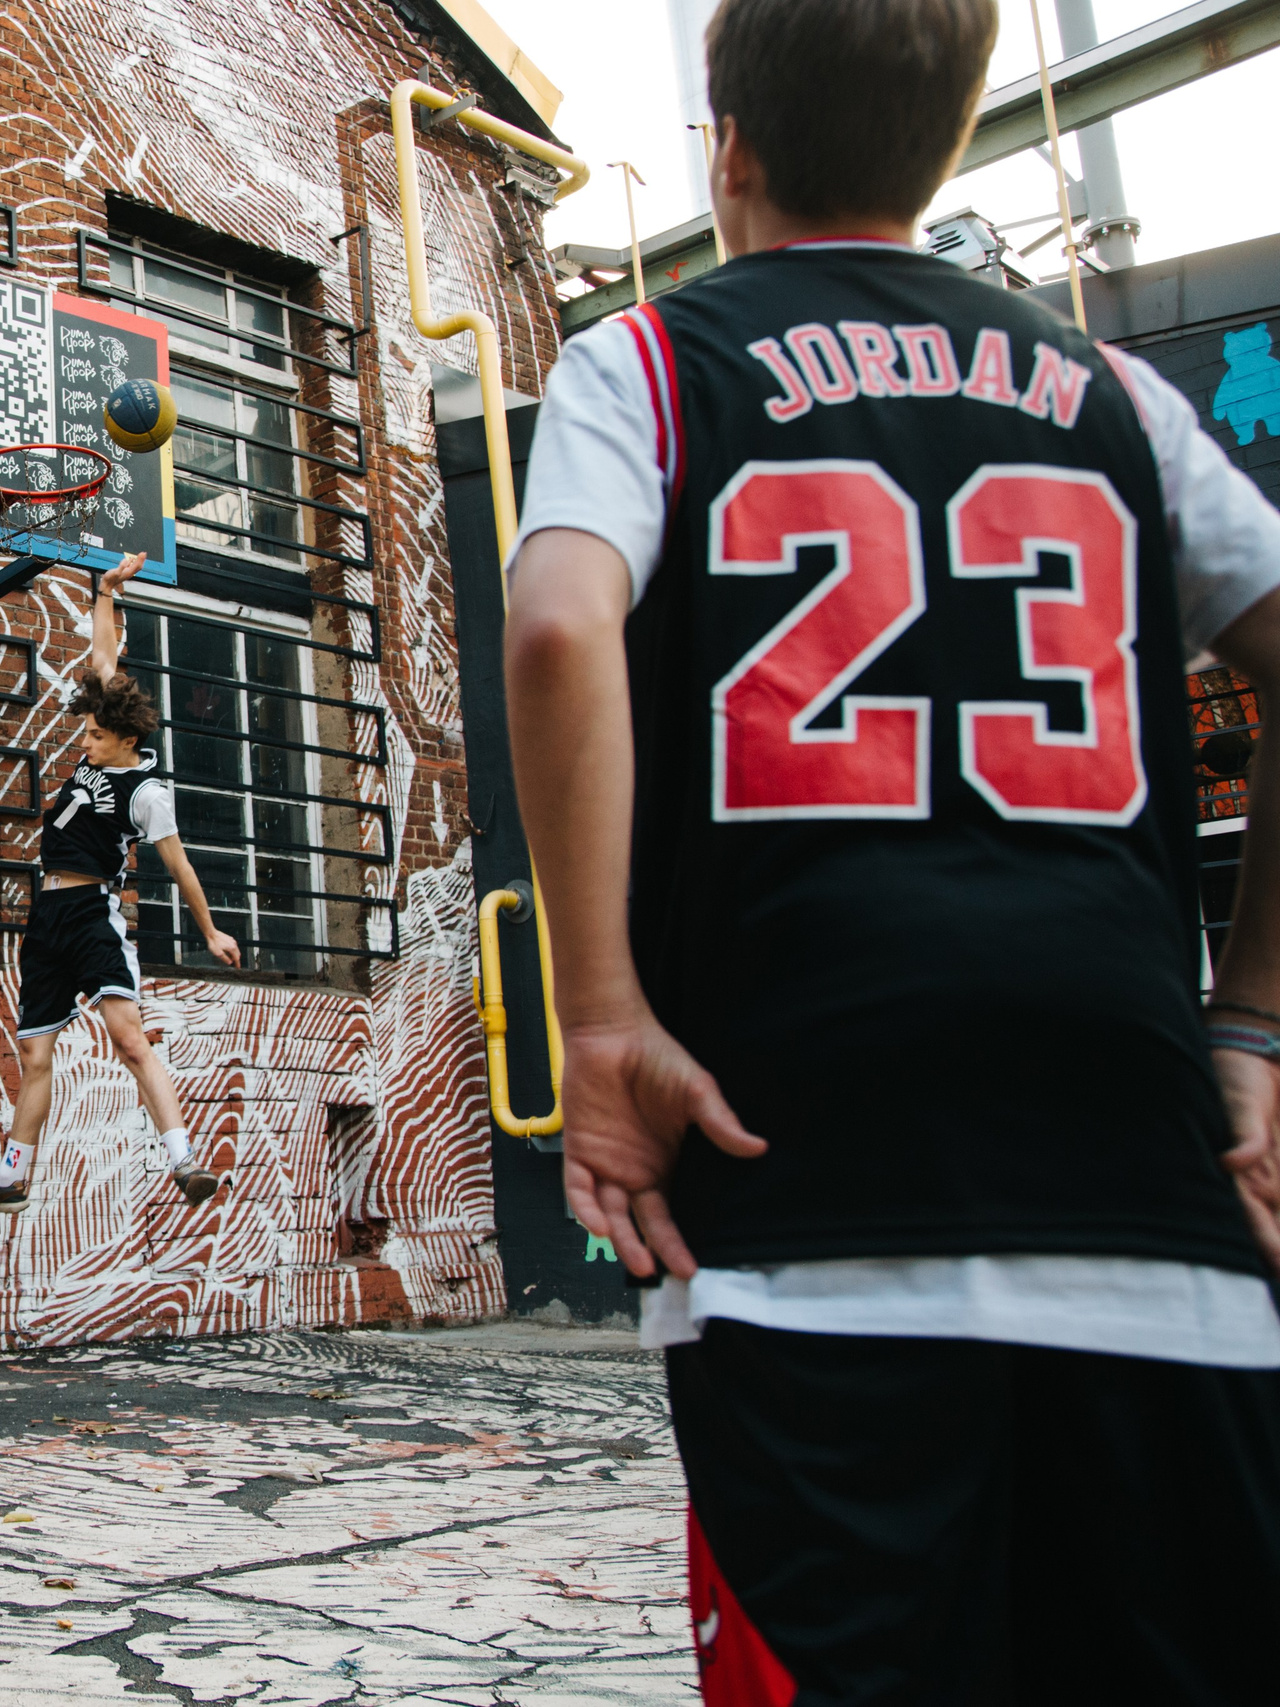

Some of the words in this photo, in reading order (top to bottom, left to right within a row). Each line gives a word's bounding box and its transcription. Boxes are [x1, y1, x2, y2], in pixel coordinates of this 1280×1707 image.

[60, 325, 91, 347] PUMA
[66, 337, 95, 354] HOOPS
[61, 355, 92, 377] PUMA
[67, 366, 97, 383] HOOPS
[747, 320, 1092, 429] JORDAN
[62, 387, 93, 409] PUMA
[136, 378, 156, 410] ARMAK
[68, 399, 97, 416] HOOPS
[63, 420, 94, 442] PUMA
[68, 432, 98, 446] HOOPS
[64, 454, 94, 476] PUMA
[70, 465, 99, 482] HOOPS
[708, 459, 1147, 828] 23
[74, 765, 116, 813] BROOKLYN
